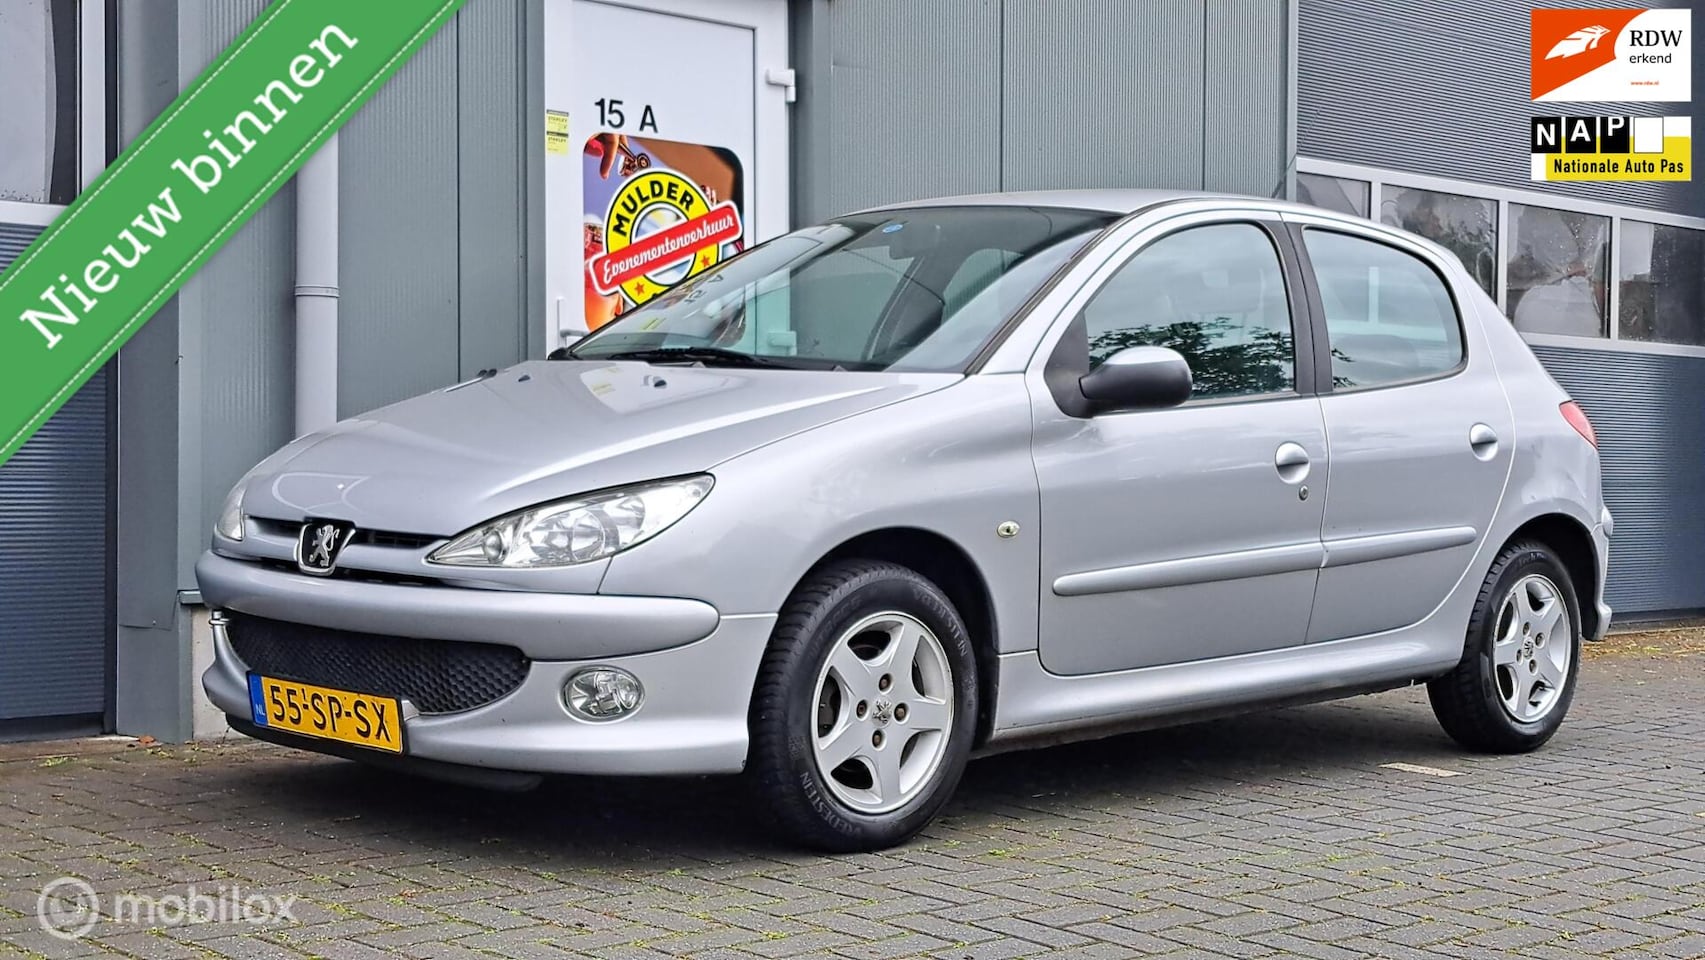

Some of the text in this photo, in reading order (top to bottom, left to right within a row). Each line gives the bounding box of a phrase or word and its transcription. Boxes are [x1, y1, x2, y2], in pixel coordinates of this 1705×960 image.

[594, 97, 659, 133] 15 A
[612, 180, 695, 238] MULDER
[602, 214, 735, 285] Evenementenverhuur
[255, 684, 392, 743] NL 55-SP-SX
